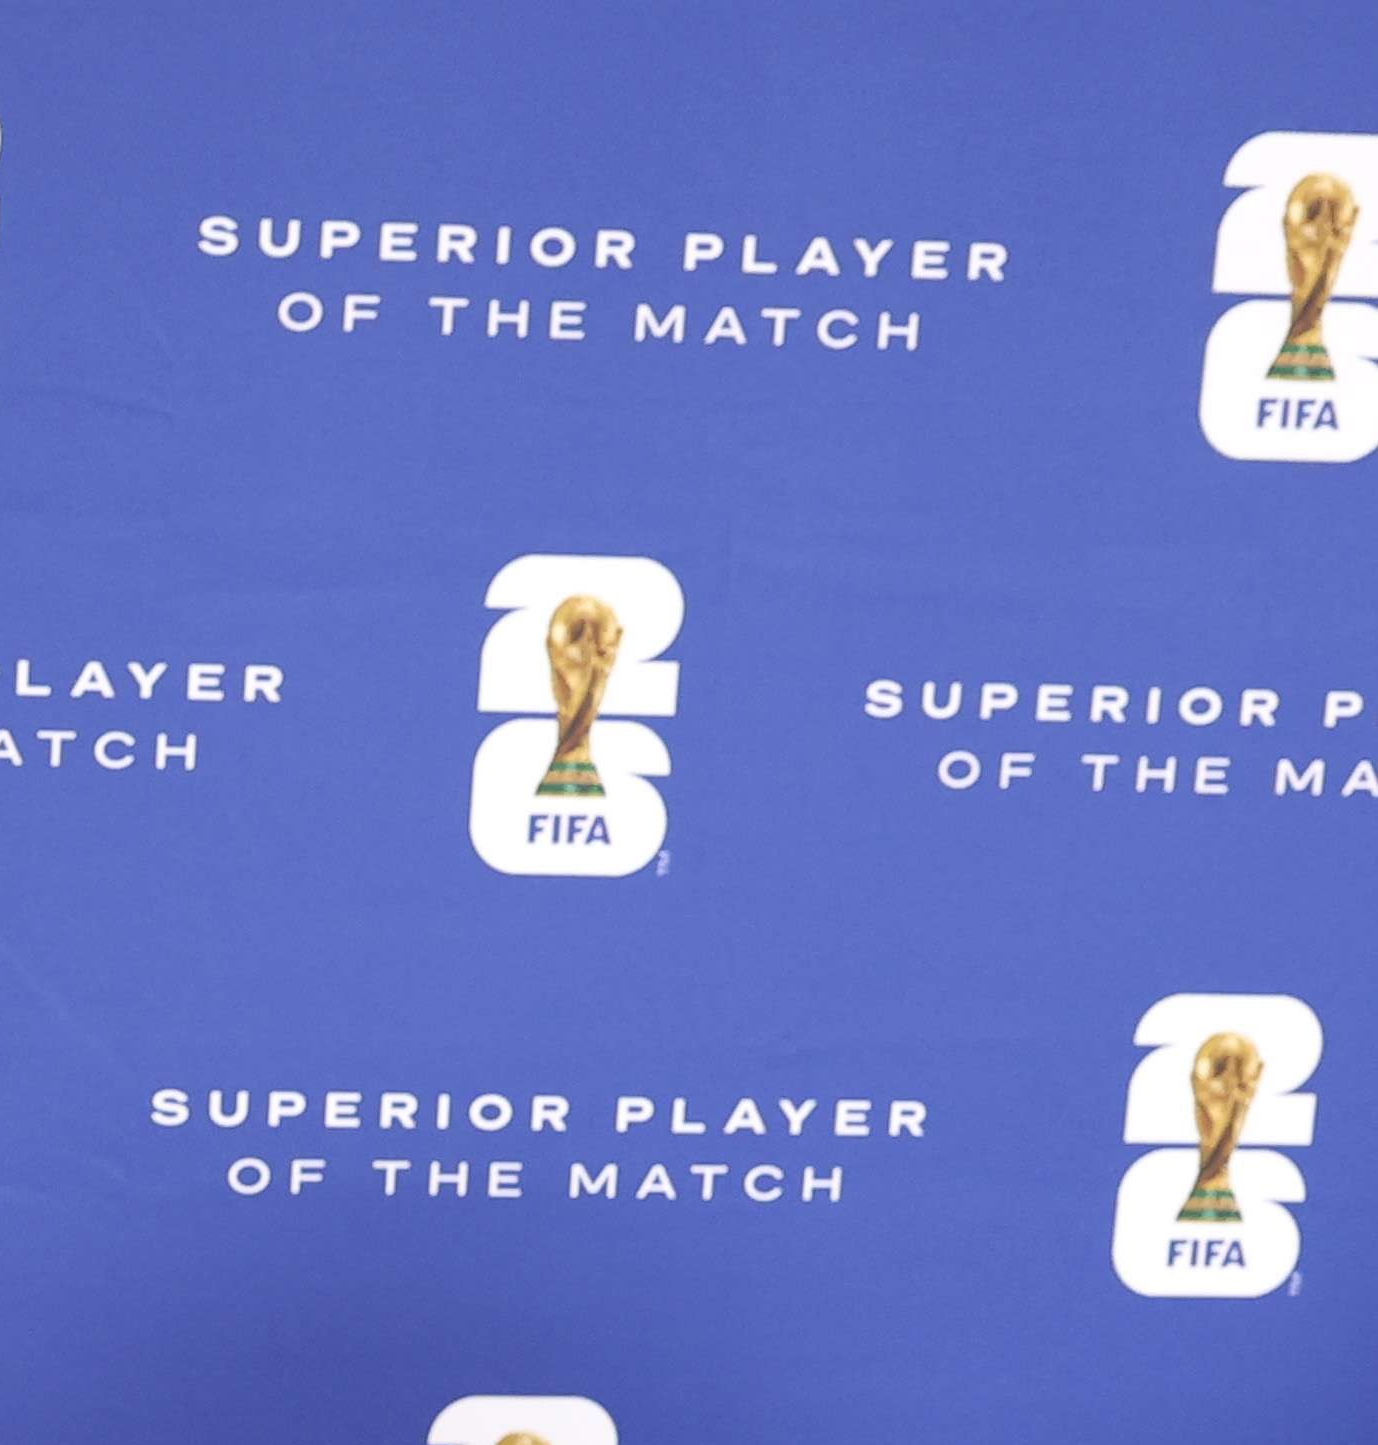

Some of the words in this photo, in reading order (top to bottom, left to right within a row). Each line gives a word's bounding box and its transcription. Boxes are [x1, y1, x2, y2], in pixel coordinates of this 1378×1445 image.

[199, 216, 634, 268] SUPERIOR
[684, 234, 1006, 281] PLAYER
[279, 293, 380, 332] OF
[430, 297, 586, 339] THE
[635, 304, 919, 350] MATCH
[1257, 398, 1338, 429] FIFA
[865, 680, 1279, 727] SUPERIOR
[939, 751, 1034, 788] OF
[1082, 755, 1230, 793] THE
[528, 814, 610, 845] FIFA
[151, 1090, 568, 1131] SUPERIOR
[617, 1097, 926, 1136] PLAYER
[228, 1158, 325, 1194] OF
[373, 1161, 522, 1197] THE
[570, 1164, 842, 1201] MATCH
[1167, 1239, 1245, 1267] FIFA
